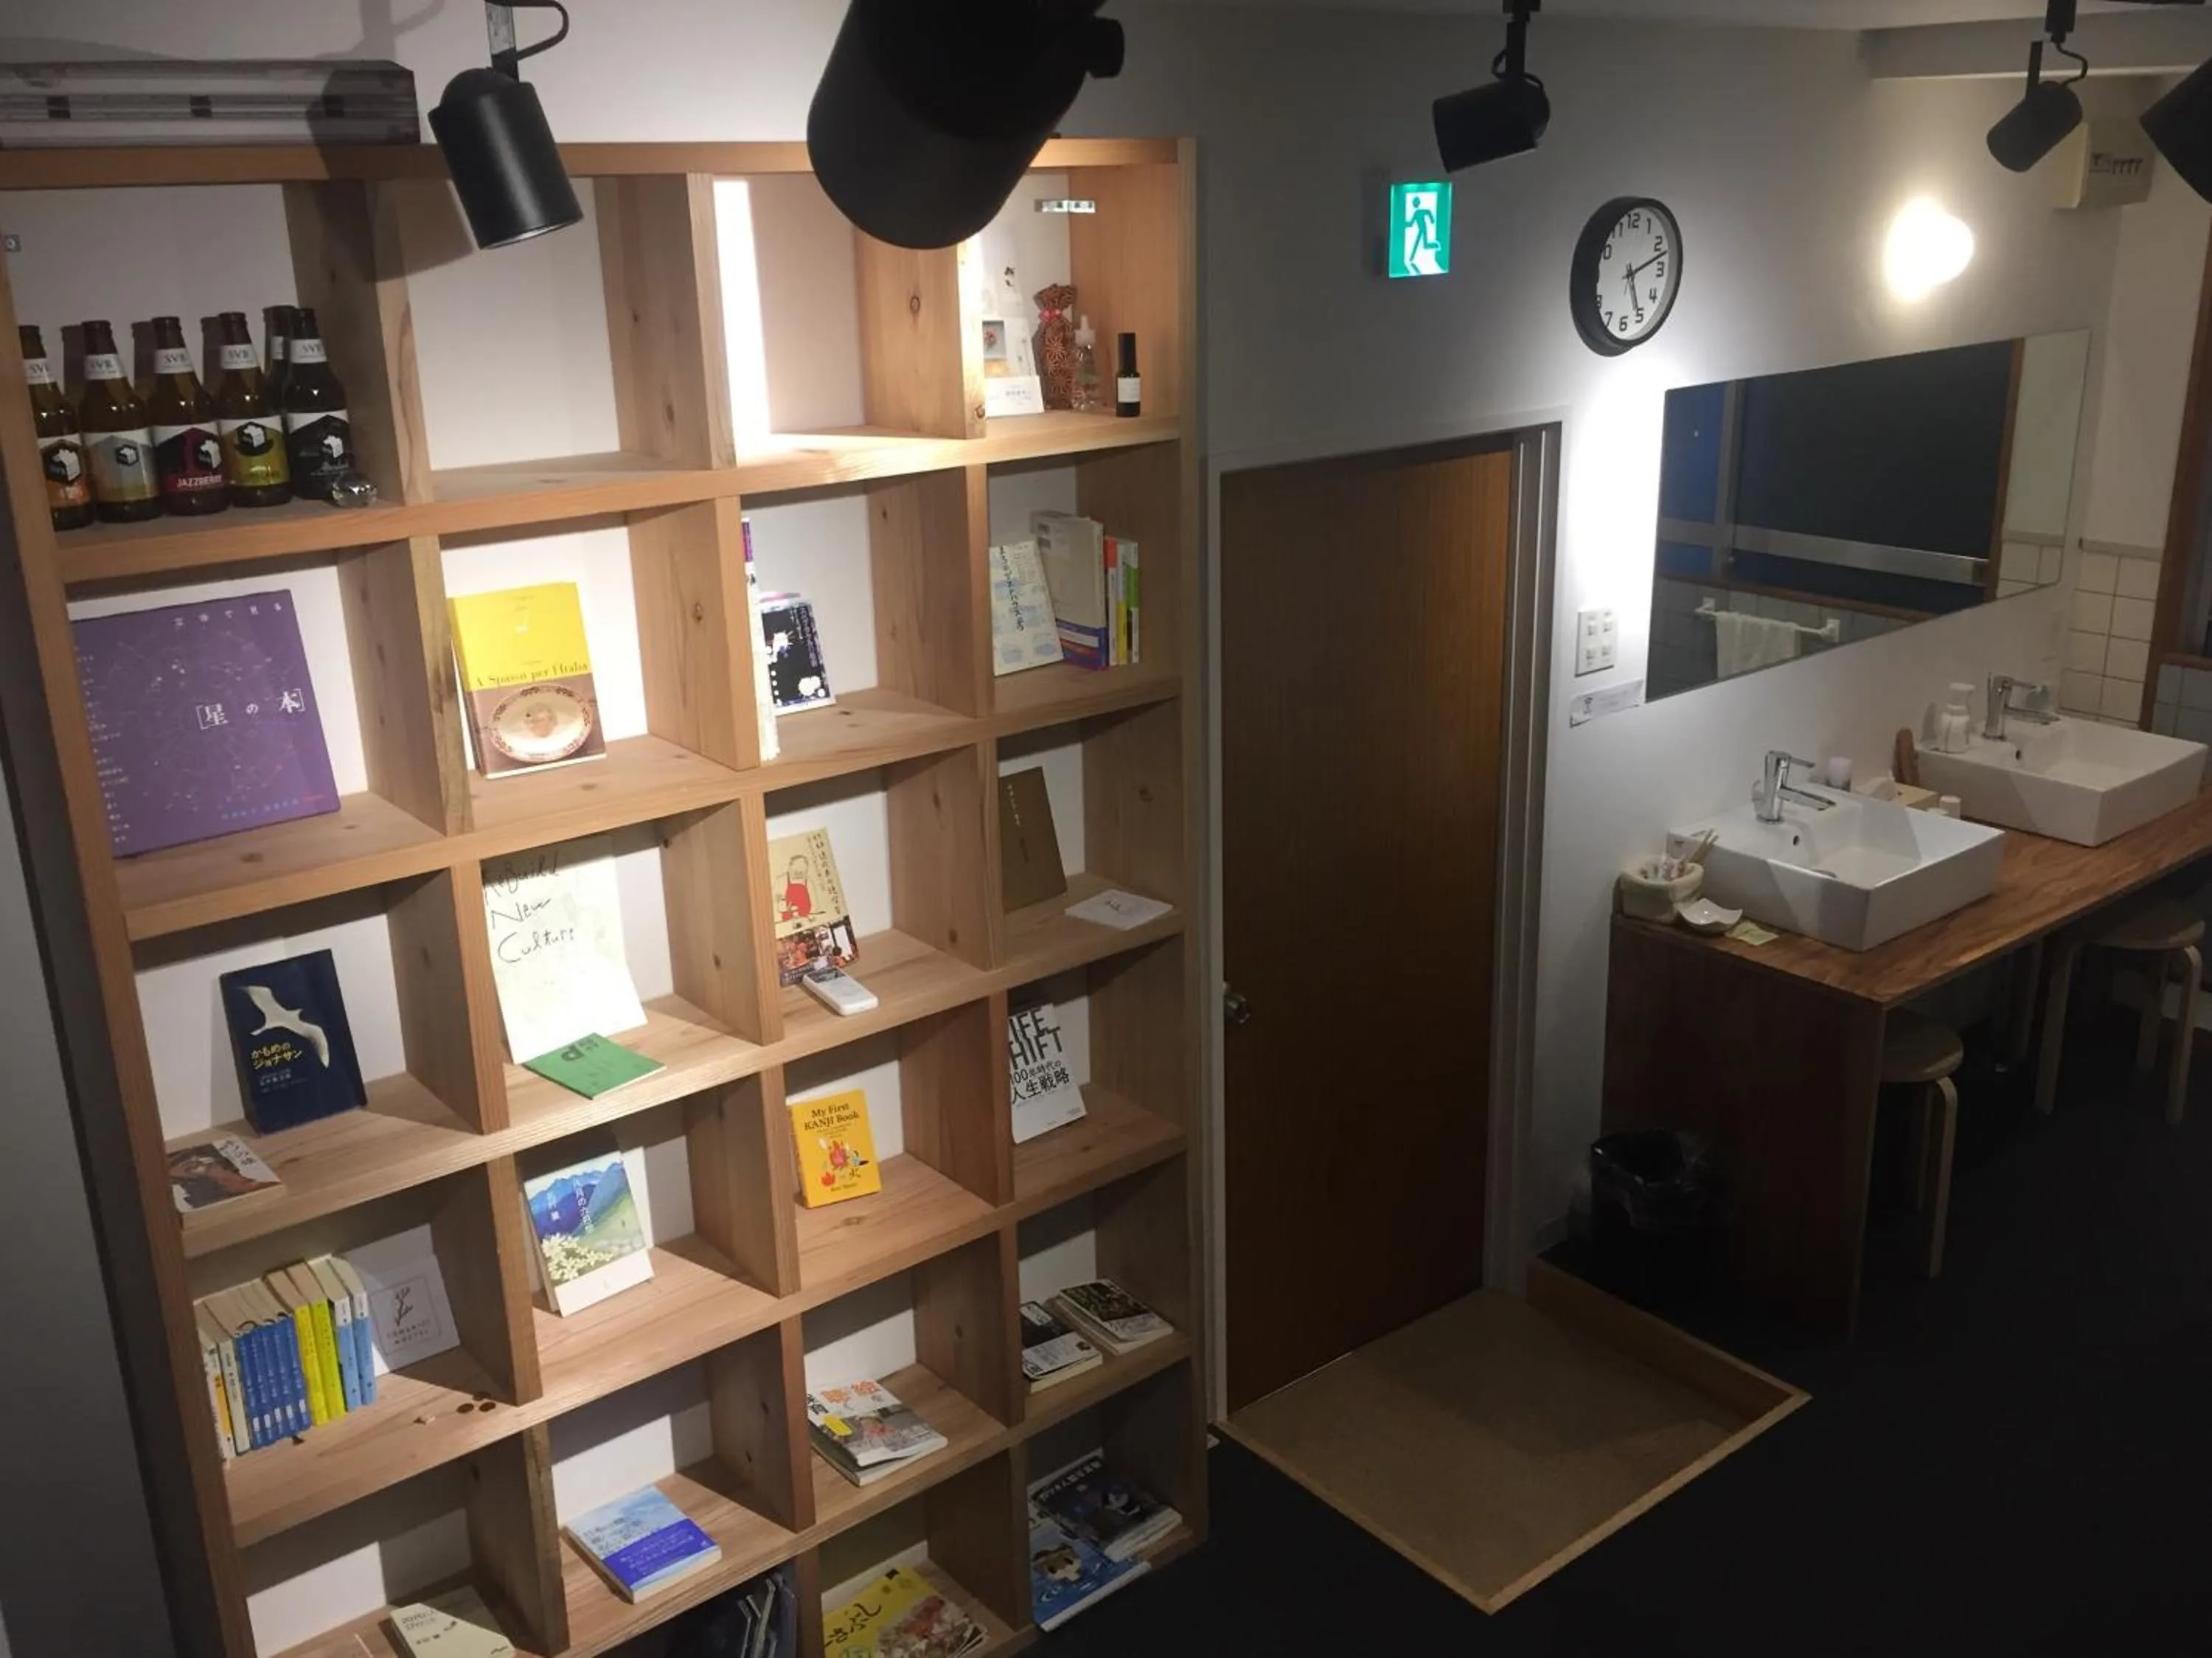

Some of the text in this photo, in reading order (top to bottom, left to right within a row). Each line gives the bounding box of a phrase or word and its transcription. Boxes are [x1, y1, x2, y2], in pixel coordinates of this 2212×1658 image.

[1627, 212, 1641, 229] 12
[1646, 218, 1652, 235] 1
[1654, 236, 1663, 252] 2
[1655, 261, 1665, 278] 3
[1649, 288, 1658, 303] 4
[1604, 311, 1613, 327] 7
[1618, 316, 1628, 331] 6
[1635, 308, 1644, 323] 5
[490, 898, 552, 930] New
[1009, 1007, 1048, 1044] IFE
[1009, 1026, 1062, 1069] HIFT
[1012, 1067, 1070, 1104] 人生戦略
[804, 1116, 835, 1131] KANJI
[836, 1110, 860, 1123] Book
[812, 1109, 827, 1120] My
